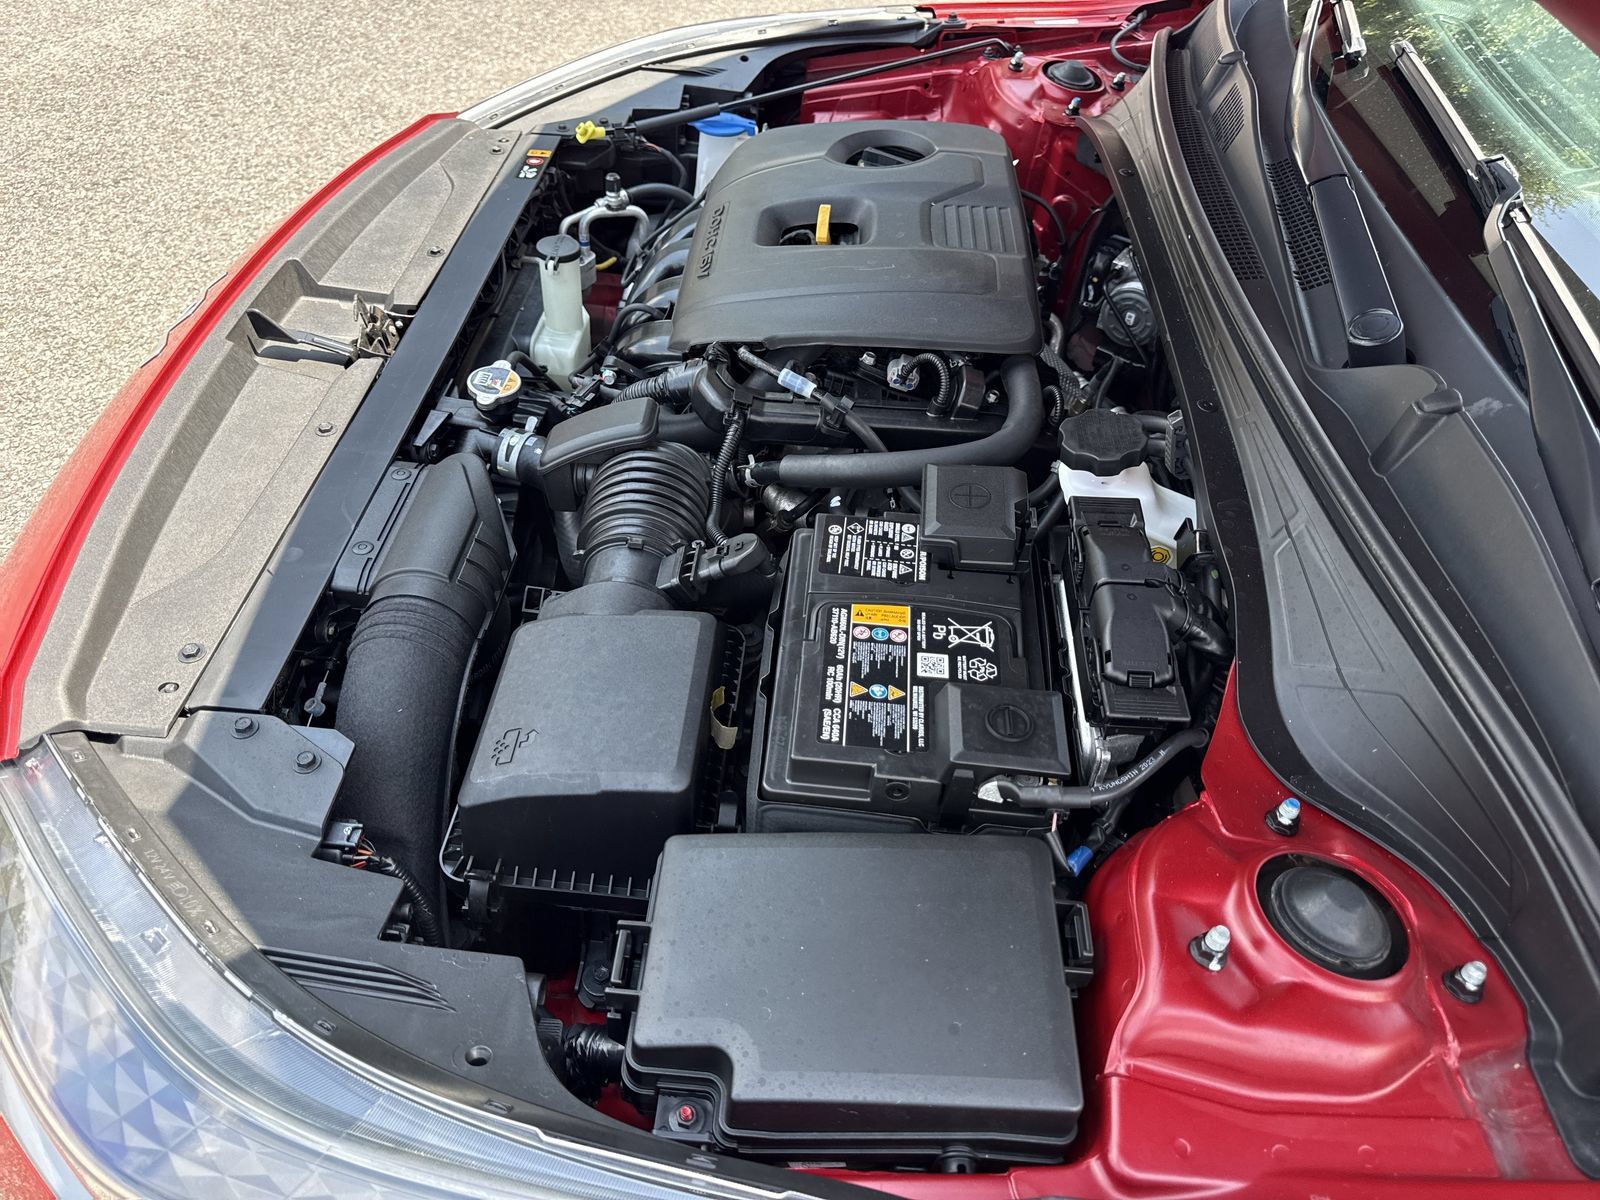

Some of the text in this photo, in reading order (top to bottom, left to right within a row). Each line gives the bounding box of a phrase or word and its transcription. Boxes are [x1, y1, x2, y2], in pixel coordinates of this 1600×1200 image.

[697, 205, 725, 280] DOHC 16V
[932, 624, 947, 640] Pb
[833, 708, 841, 723] CCA
